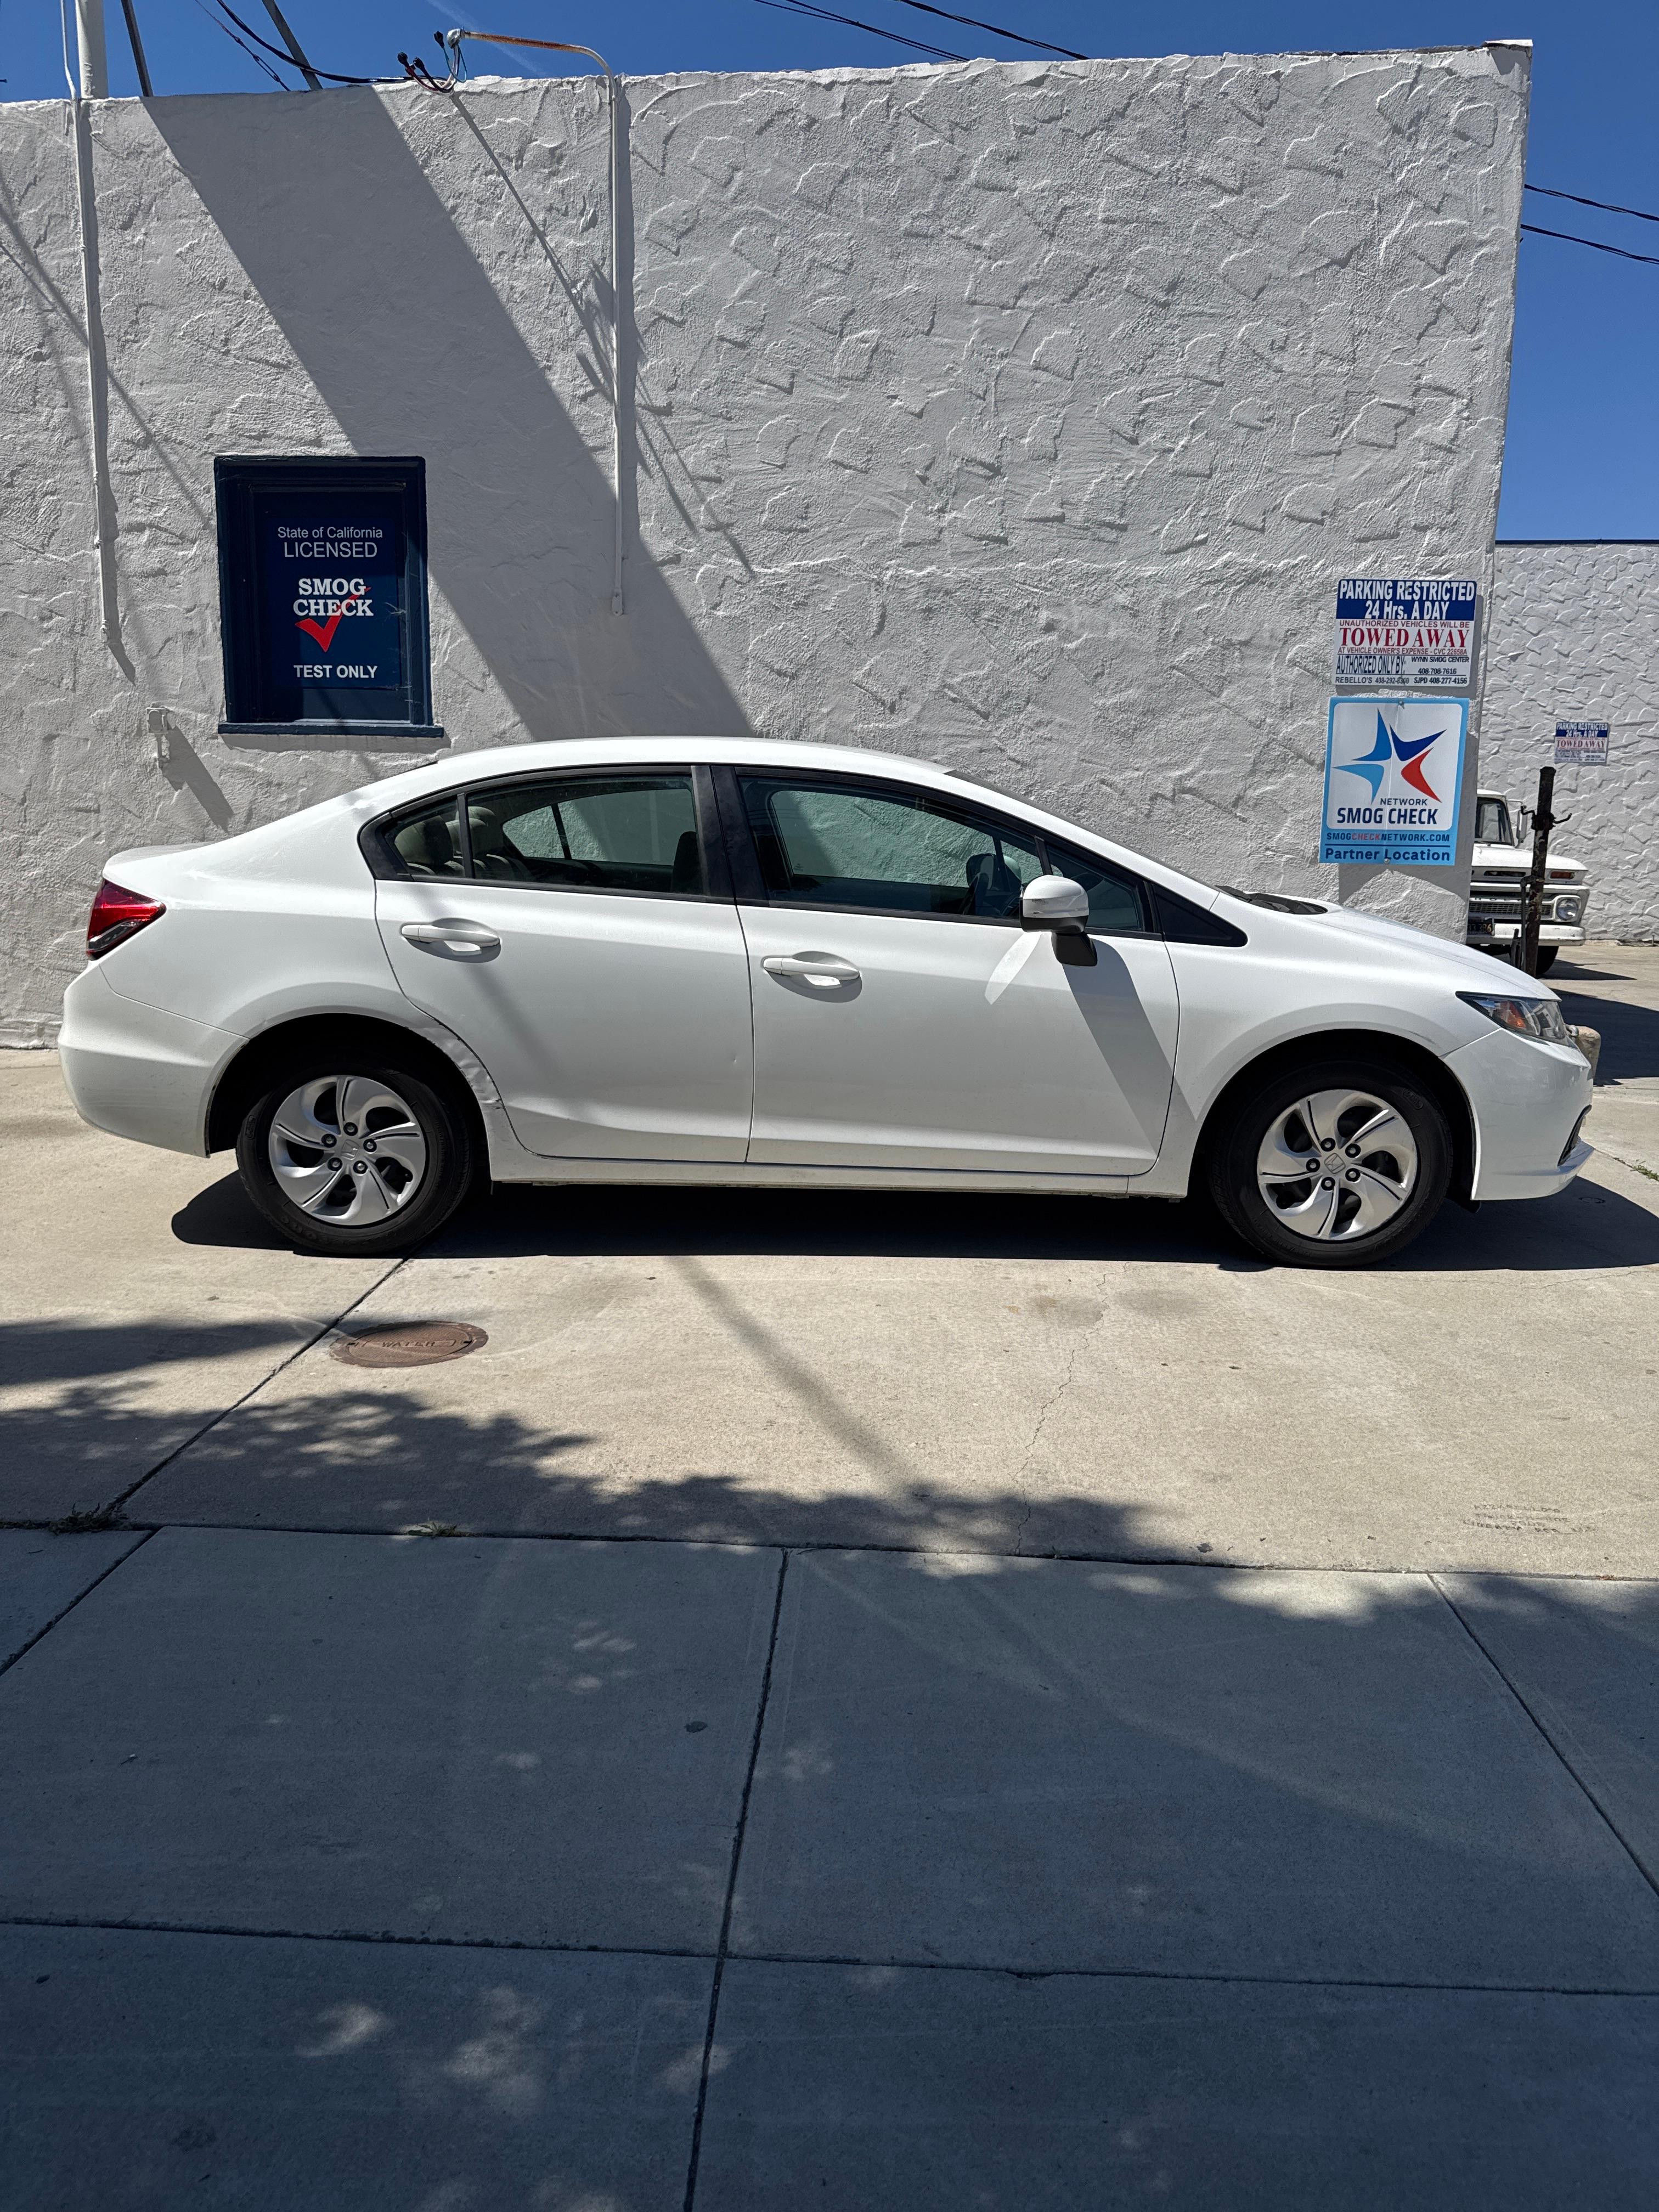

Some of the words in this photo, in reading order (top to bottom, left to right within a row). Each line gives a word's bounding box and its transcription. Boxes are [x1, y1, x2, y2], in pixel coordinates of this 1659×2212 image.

[278, 527, 308, 539] State
[312, 526, 324, 539] of
[327, 526, 383, 539] California
[284, 541, 377, 558] LICENSED
[298, 578, 366, 596] SMOG
[1339, 580, 1393, 600] PARKING
[1396, 582, 1475, 601] RESTRICTED
[293, 599, 374, 617] CHECK
[1365, 600, 1380, 619] 24
[1384, 601, 1408, 619] Hrs.
[1411, 601, 1420, 619] A
[1424, 601, 1449, 620] DAY
[1339, 628, 1409, 647] TOWED
[1412, 629, 1470, 647] AWAY
[294, 665, 332, 678] TEST
[336, 665, 378, 679] ONLY
[1336, 655, 1376, 674] AUTHORIZED
[1378, 656, 1395, 674] ONLY
[1396, 656, 1406, 674] BY:
[1337, 808, 1383, 823] SMOG
[1388, 809, 1438, 825] CHECK
[1327, 833, 1449, 842] SMOGCHECKNETWORK.COM
[1325, 848, 1380, 860] Partner
[1384, 849, 1450, 861] Location
